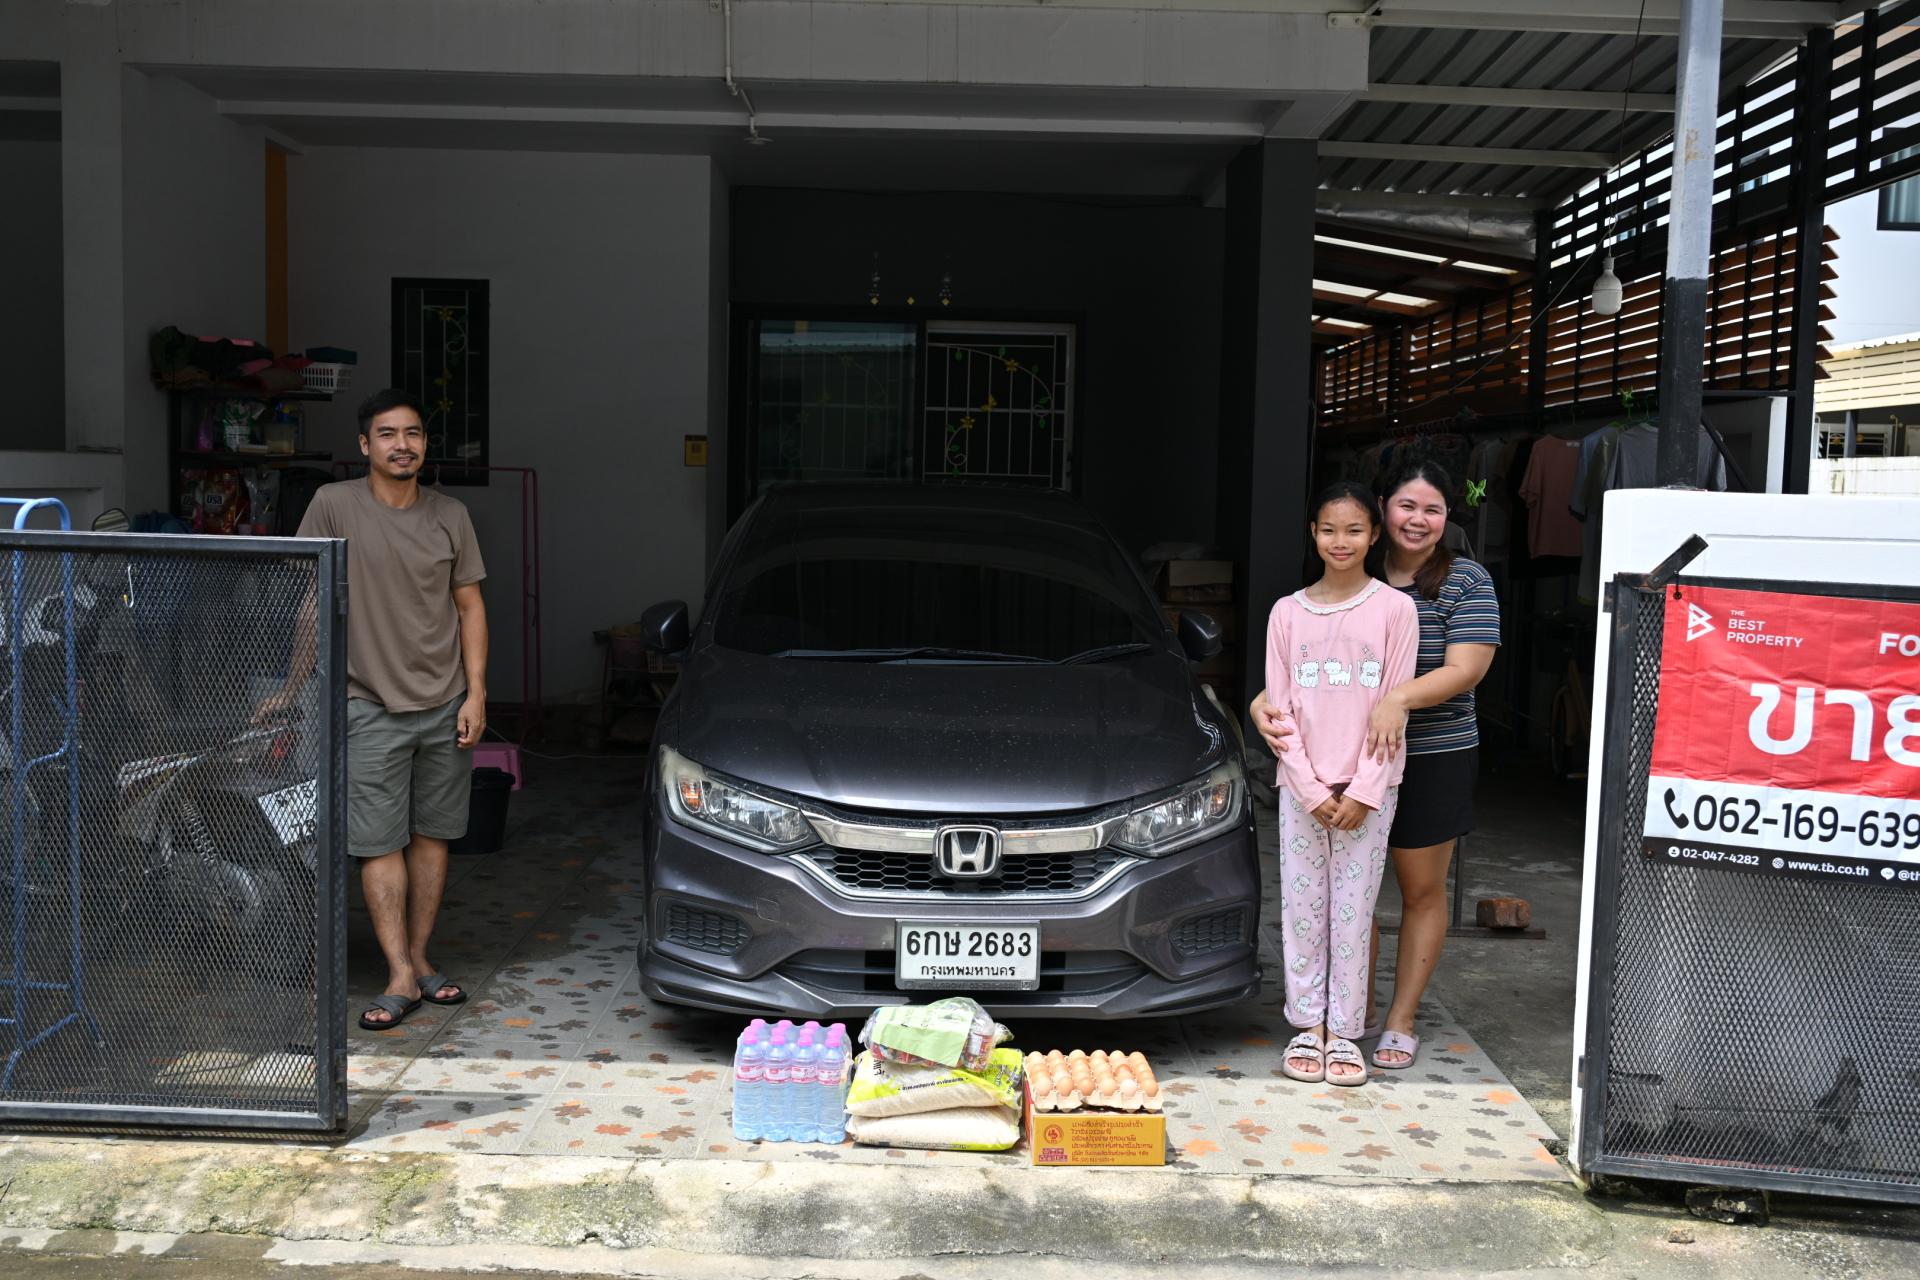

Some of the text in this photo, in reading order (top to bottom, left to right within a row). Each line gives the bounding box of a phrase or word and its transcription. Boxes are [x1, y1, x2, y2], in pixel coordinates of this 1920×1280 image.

[1730, 609, 1745, 617] THE
[1728, 618, 1766, 631] BEST
[1726, 631, 1804, 648] PROPERTY
[1693, 794, 1920, 850] 062-169-639
[1682, 848, 1759, 866] 02-047-4282
[1787, 860, 1870, 877] www.tb.co.th
[906, 930, 1032, 957] 6กษ 2683
[921, 965, 1016, 979] กรุงเทพมหานคร
